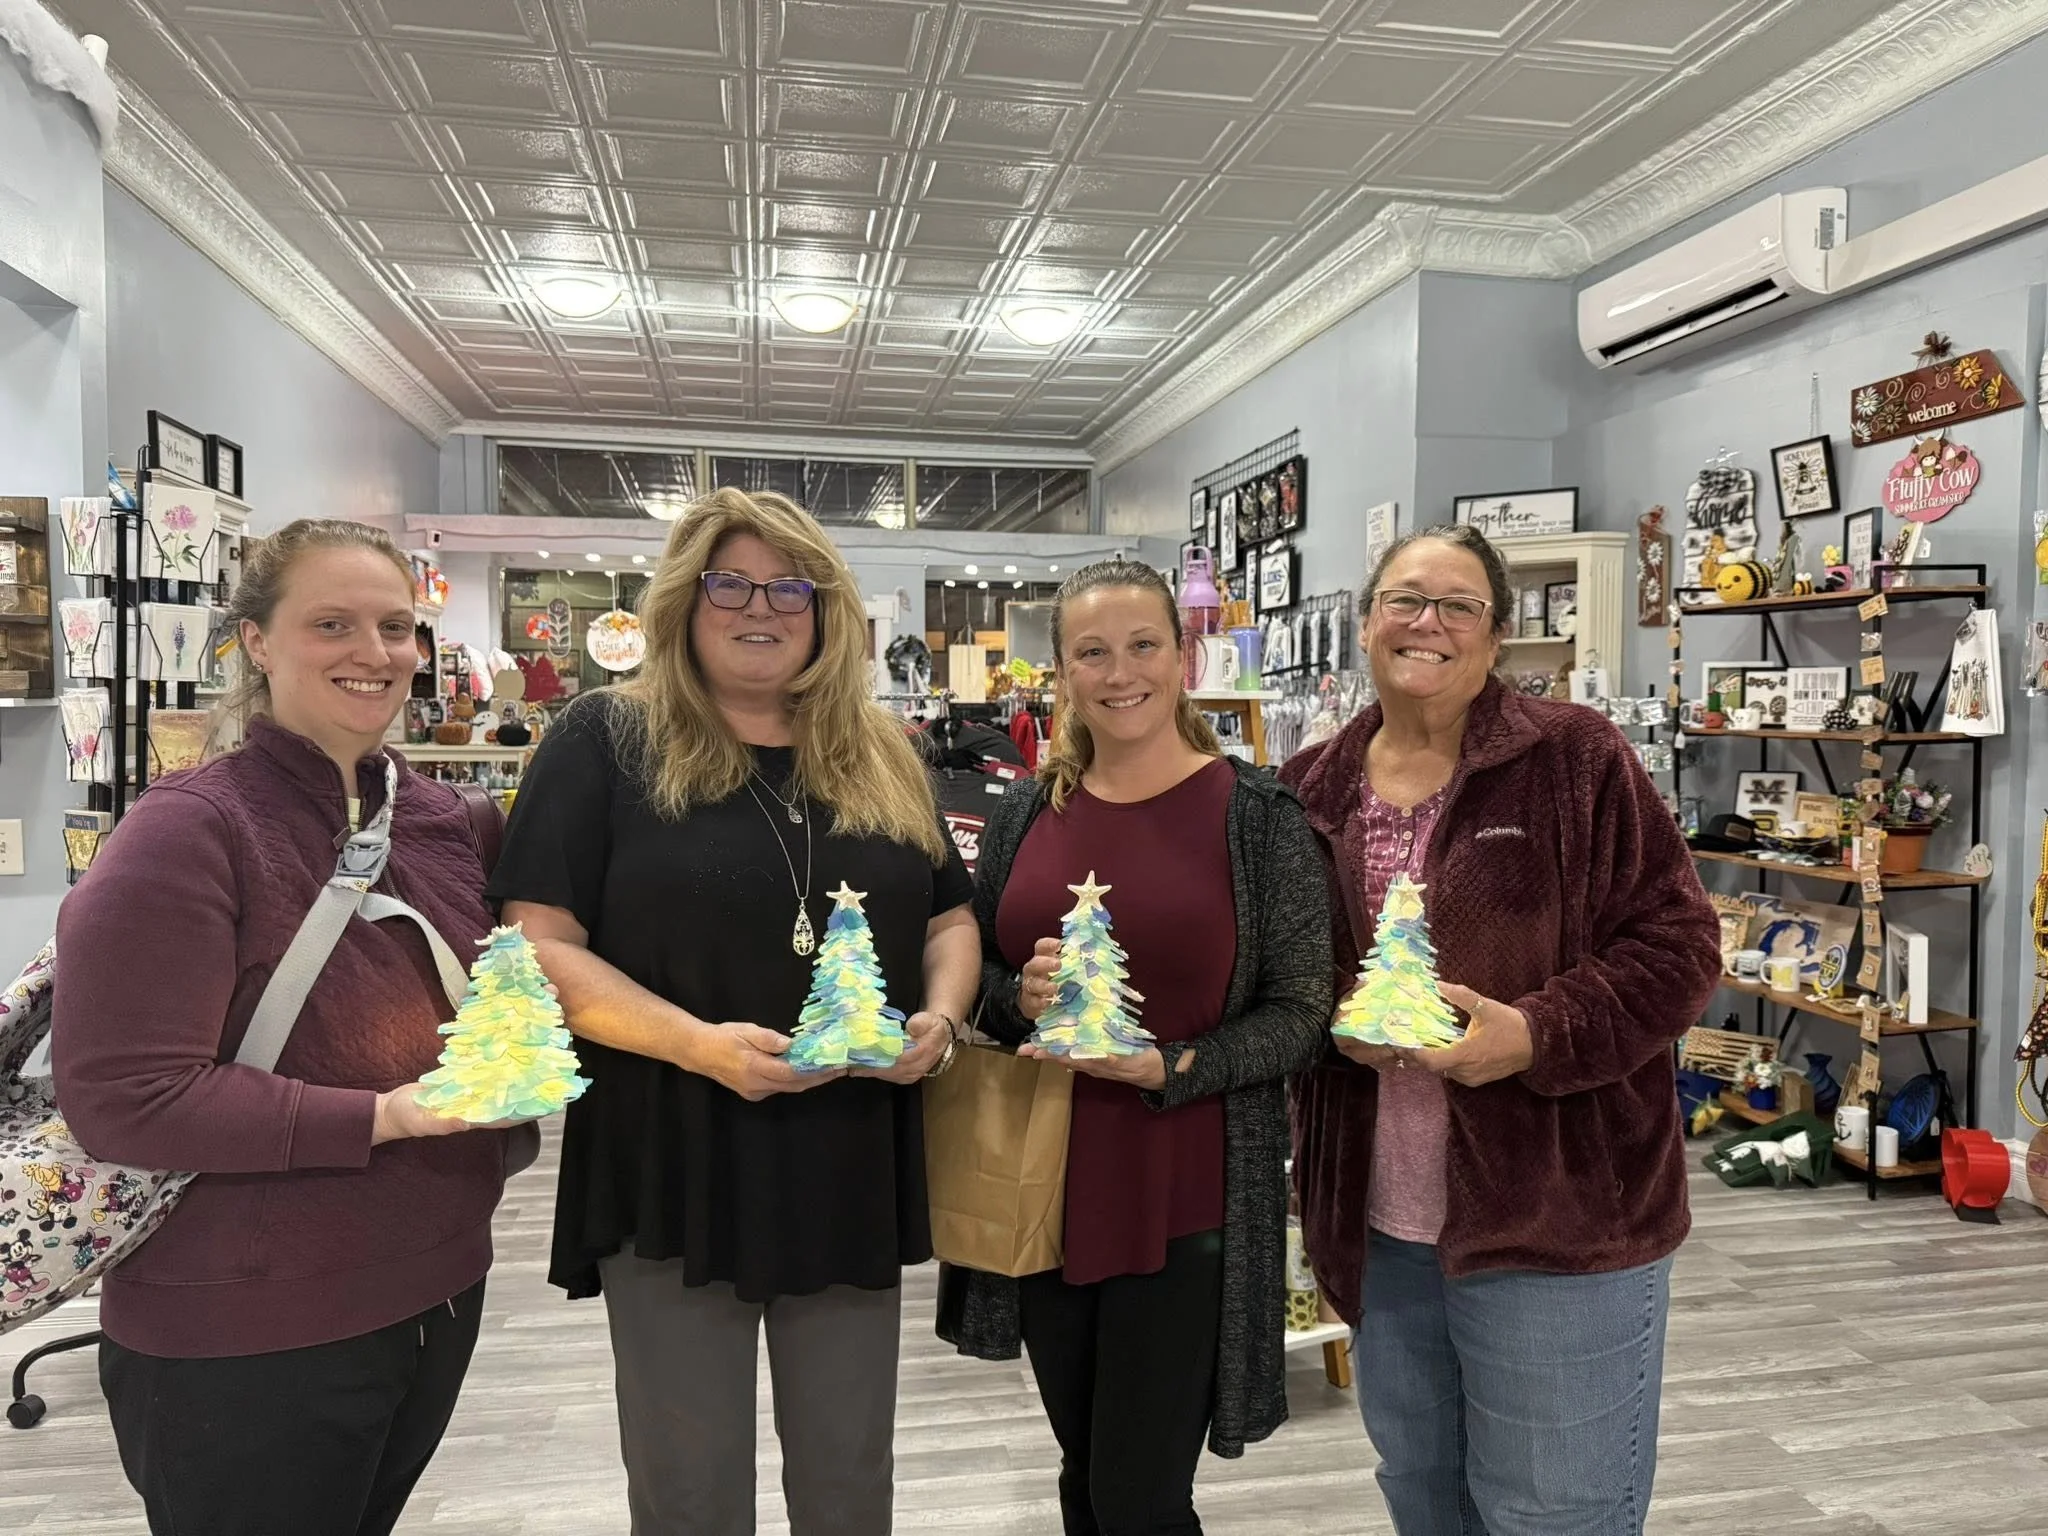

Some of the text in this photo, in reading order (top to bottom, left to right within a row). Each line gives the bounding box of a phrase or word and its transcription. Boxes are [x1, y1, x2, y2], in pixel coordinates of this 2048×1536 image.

[1908, 401, 1957, 424] welcome
[1886, 475, 1936, 502] Fluffy
[1458, 499, 1541, 537] Together
[1802, 672, 1839, 690] KNOW
[1793, 690, 1837, 700] HOW IT WILL
